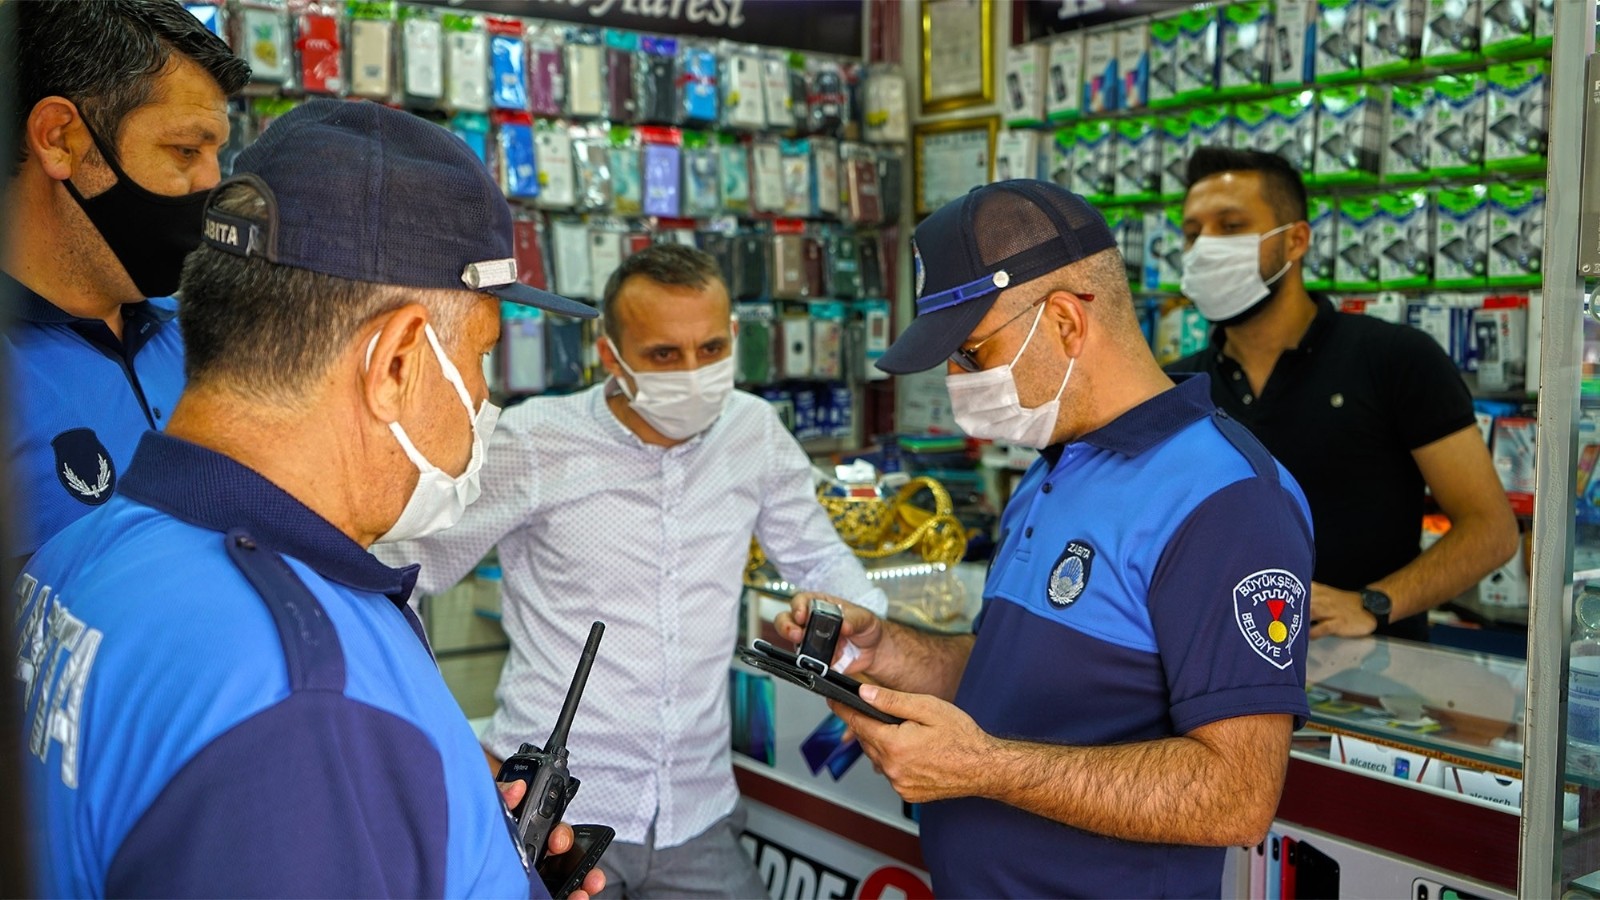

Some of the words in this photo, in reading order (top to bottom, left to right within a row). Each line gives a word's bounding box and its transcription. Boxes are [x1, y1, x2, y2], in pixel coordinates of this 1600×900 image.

[1067, 543, 1091, 559] ZABITA
[1238, 574, 1302, 599] BÜYÜKŞEHİR
[1241, 612, 1282, 657] BELEDİYE
[1349, 757, 1388, 773] alcatech
